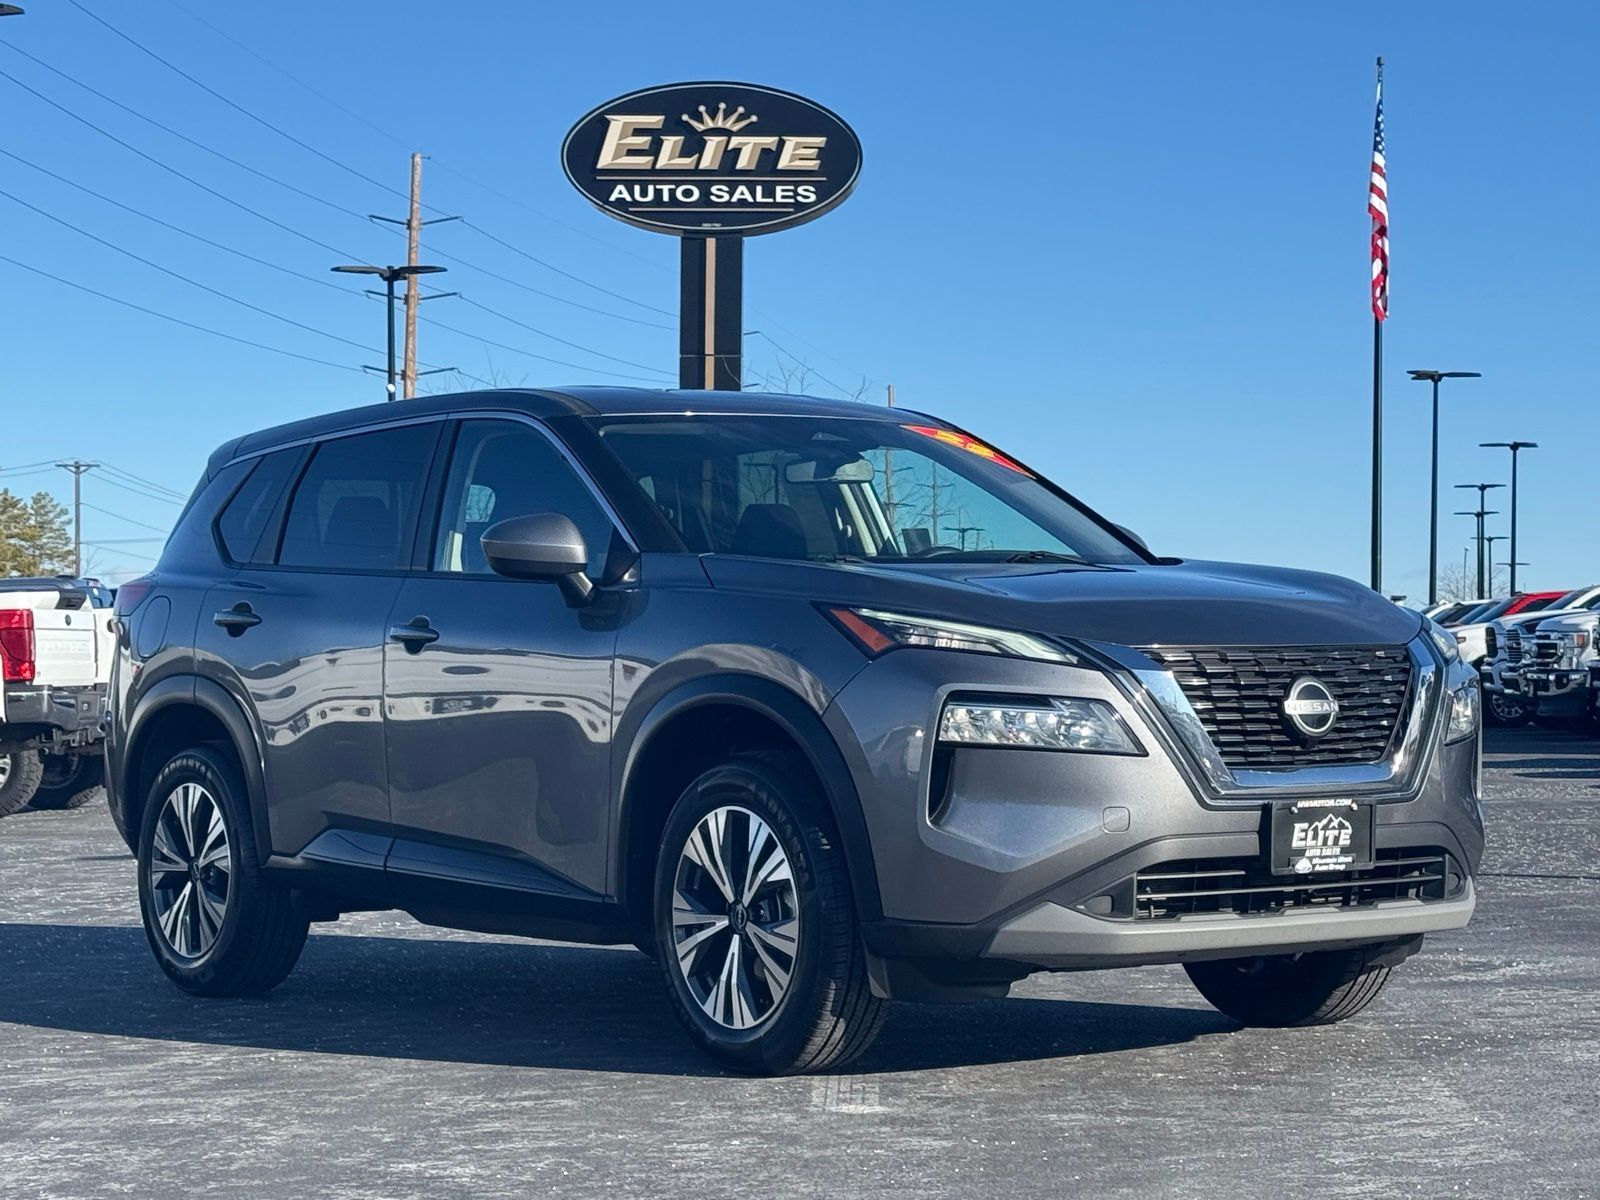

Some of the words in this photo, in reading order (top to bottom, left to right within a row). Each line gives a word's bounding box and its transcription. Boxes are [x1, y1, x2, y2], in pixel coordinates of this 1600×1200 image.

[596, 115, 828, 170] ELITE
[608, 184, 700, 203] AUTO
[709, 185, 817, 203] SALES
[1286, 701, 1339, 714] NISSAN
[1291, 823, 1352, 849] ELITE
